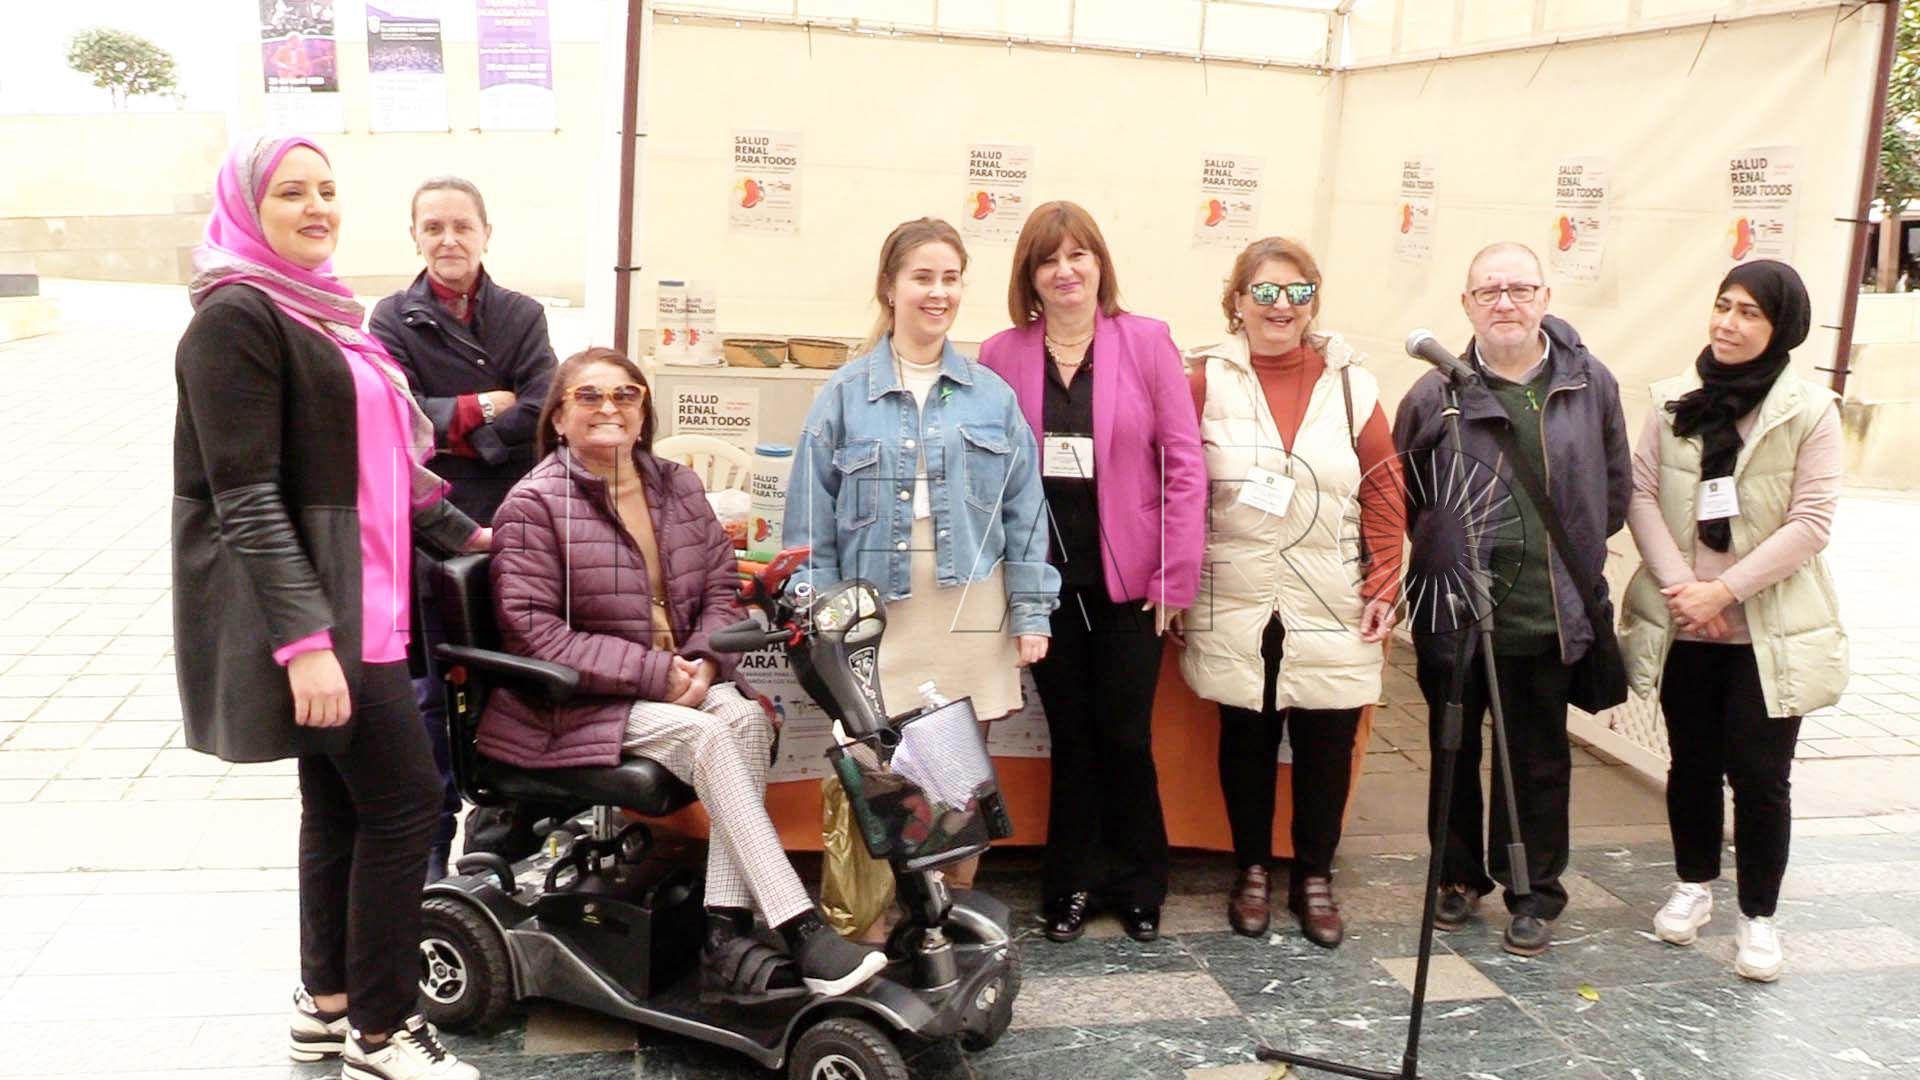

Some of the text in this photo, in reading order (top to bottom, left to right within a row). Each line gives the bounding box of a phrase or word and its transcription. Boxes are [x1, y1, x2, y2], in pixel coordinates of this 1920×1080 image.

[735, 136, 769, 146] SALUD
[735, 146, 768, 155] RENAL
[970, 150, 1002, 160] SALUD
[735, 155, 797, 166] PARA TODOS
[970, 160, 1000, 168] RENAL
[1204, 159, 1236, 168] SALUD
[1730, 158, 1768, 171] SALUD
[969, 168, 1027, 178] PARA TODOS
[1203, 168, 1233, 178] RENAL
[1558, 165, 1584, 175] SALUD
[1202, 177, 1258, 188] PARA TODOS
[1557, 176, 1582, 186] RENAL
[1731, 172, 1766, 184] RENAL
[1556, 188, 1604, 198] PARA TODOS
[1732, 184, 1792, 196] PARA TODOS
[679, 394, 719, 404] SALUD
[679, 405, 718, 415] RENAL
[679, 416, 751, 426] PARA TODOS
[753, 474, 778, 483] SALUD
[753, 482, 777, 490] RENAL
[742, 655, 778, 668] ARA
